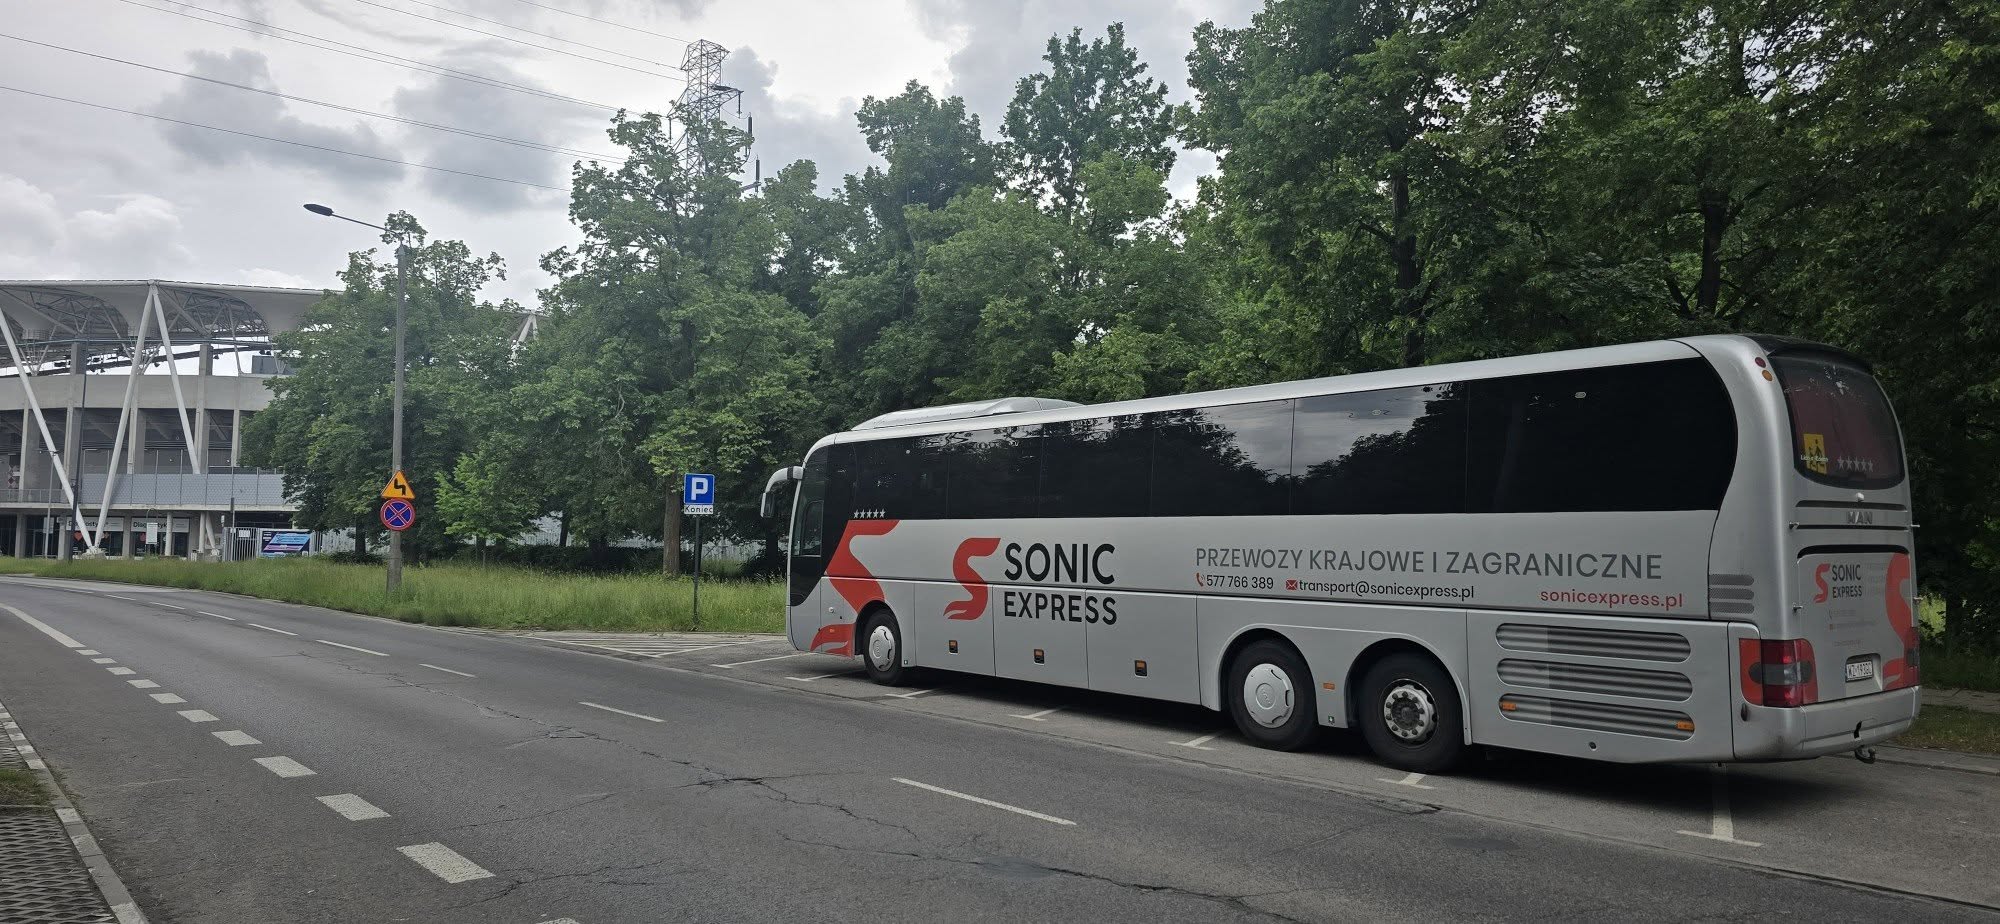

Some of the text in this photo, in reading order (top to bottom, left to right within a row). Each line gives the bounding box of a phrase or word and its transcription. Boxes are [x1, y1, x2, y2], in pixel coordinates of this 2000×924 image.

[690, 477, 709, 501] P
[684, 505, 713, 513] Koniec
[1847, 511, 1873, 525] MAN
[1004, 542, 1116, 585] SONIC
[1196, 548, 1662, 580] PRZEWOZY KRAJOWE I ZAGRANICZNE
[1832, 564, 1861, 581] SONIC
[1206, 574, 1274, 590] 577 766 389
[1299, 579, 1475, 602] transport@sonicexpress.pl
[1832, 585, 1862, 599] EXPRESS
[1004, 591, 1118, 626] EXPRESS
[1540, 588, 1683, 611] sonicexpress.pl
